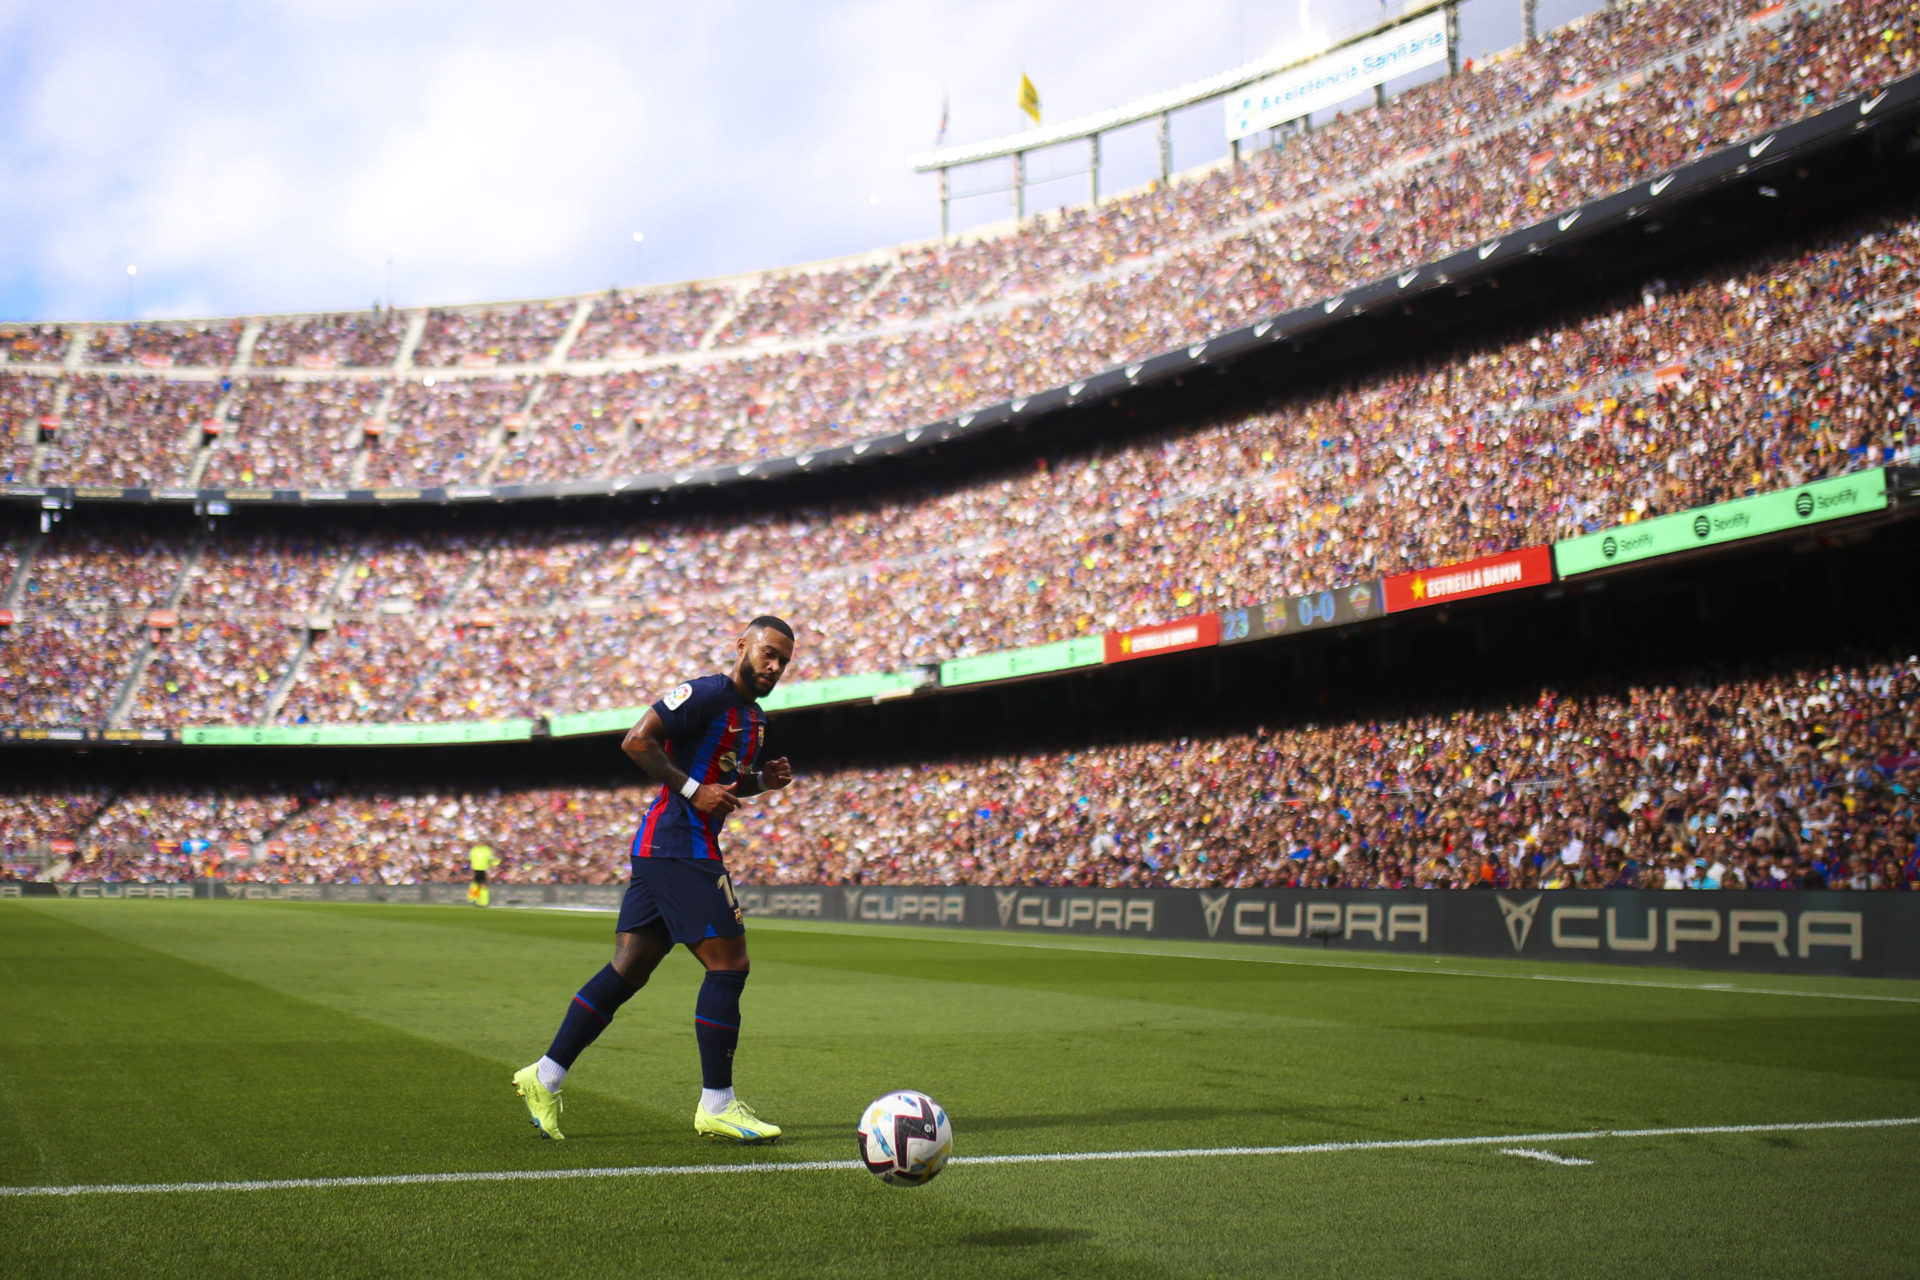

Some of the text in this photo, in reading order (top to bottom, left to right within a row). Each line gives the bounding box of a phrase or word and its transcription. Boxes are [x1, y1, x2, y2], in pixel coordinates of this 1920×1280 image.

[1427, 570, 1482, 598] ESTRELLA
[1223, 608, 1249, 640] 23
[1299, 590, 1335, 626] 0-0
[77, 884, 195, 899] CUPRA
[859, 895, 964, 923] CUPRA
[1016, 897, 1155, 932] CUPRA
[1234, 902, 1428, 943] CUPRA
[1551, 906, 1863, 960] CUPRA
